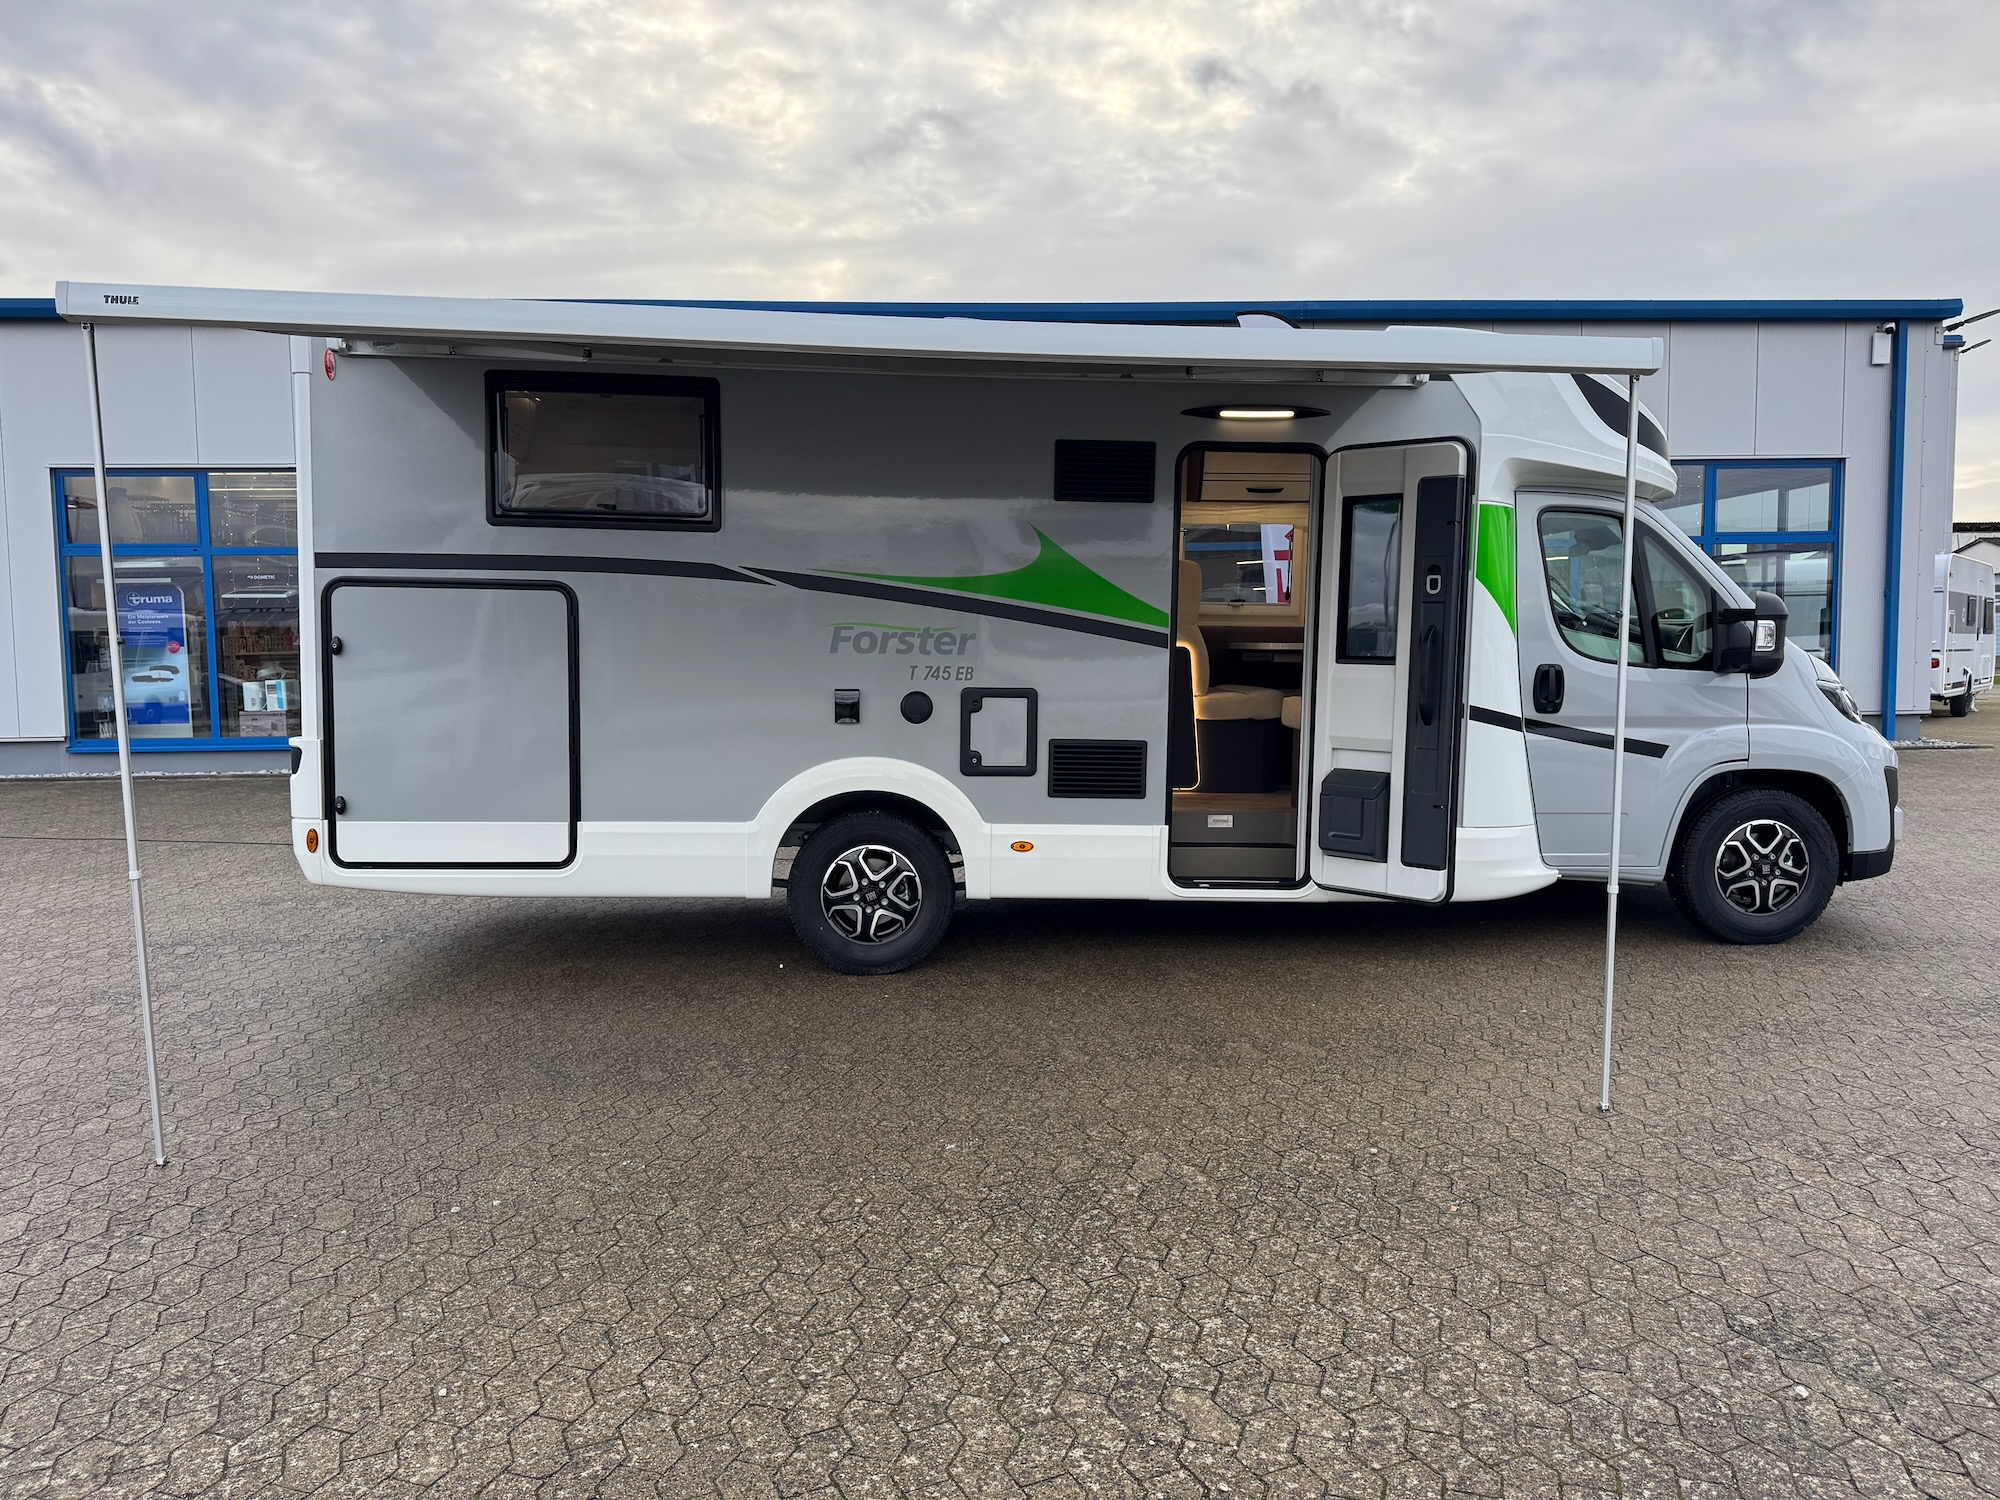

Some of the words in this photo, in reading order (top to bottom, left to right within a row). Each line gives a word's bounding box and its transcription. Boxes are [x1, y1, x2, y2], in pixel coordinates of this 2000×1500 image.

[103, 294, 139, 305] THULE
[127, 592, 173, 605] truma
[829, 626, 977, 656] Forster
[909, 665, 918, 681] T
[923, 665, 952, 681] 745
[955, 666, 975, 681] EB
